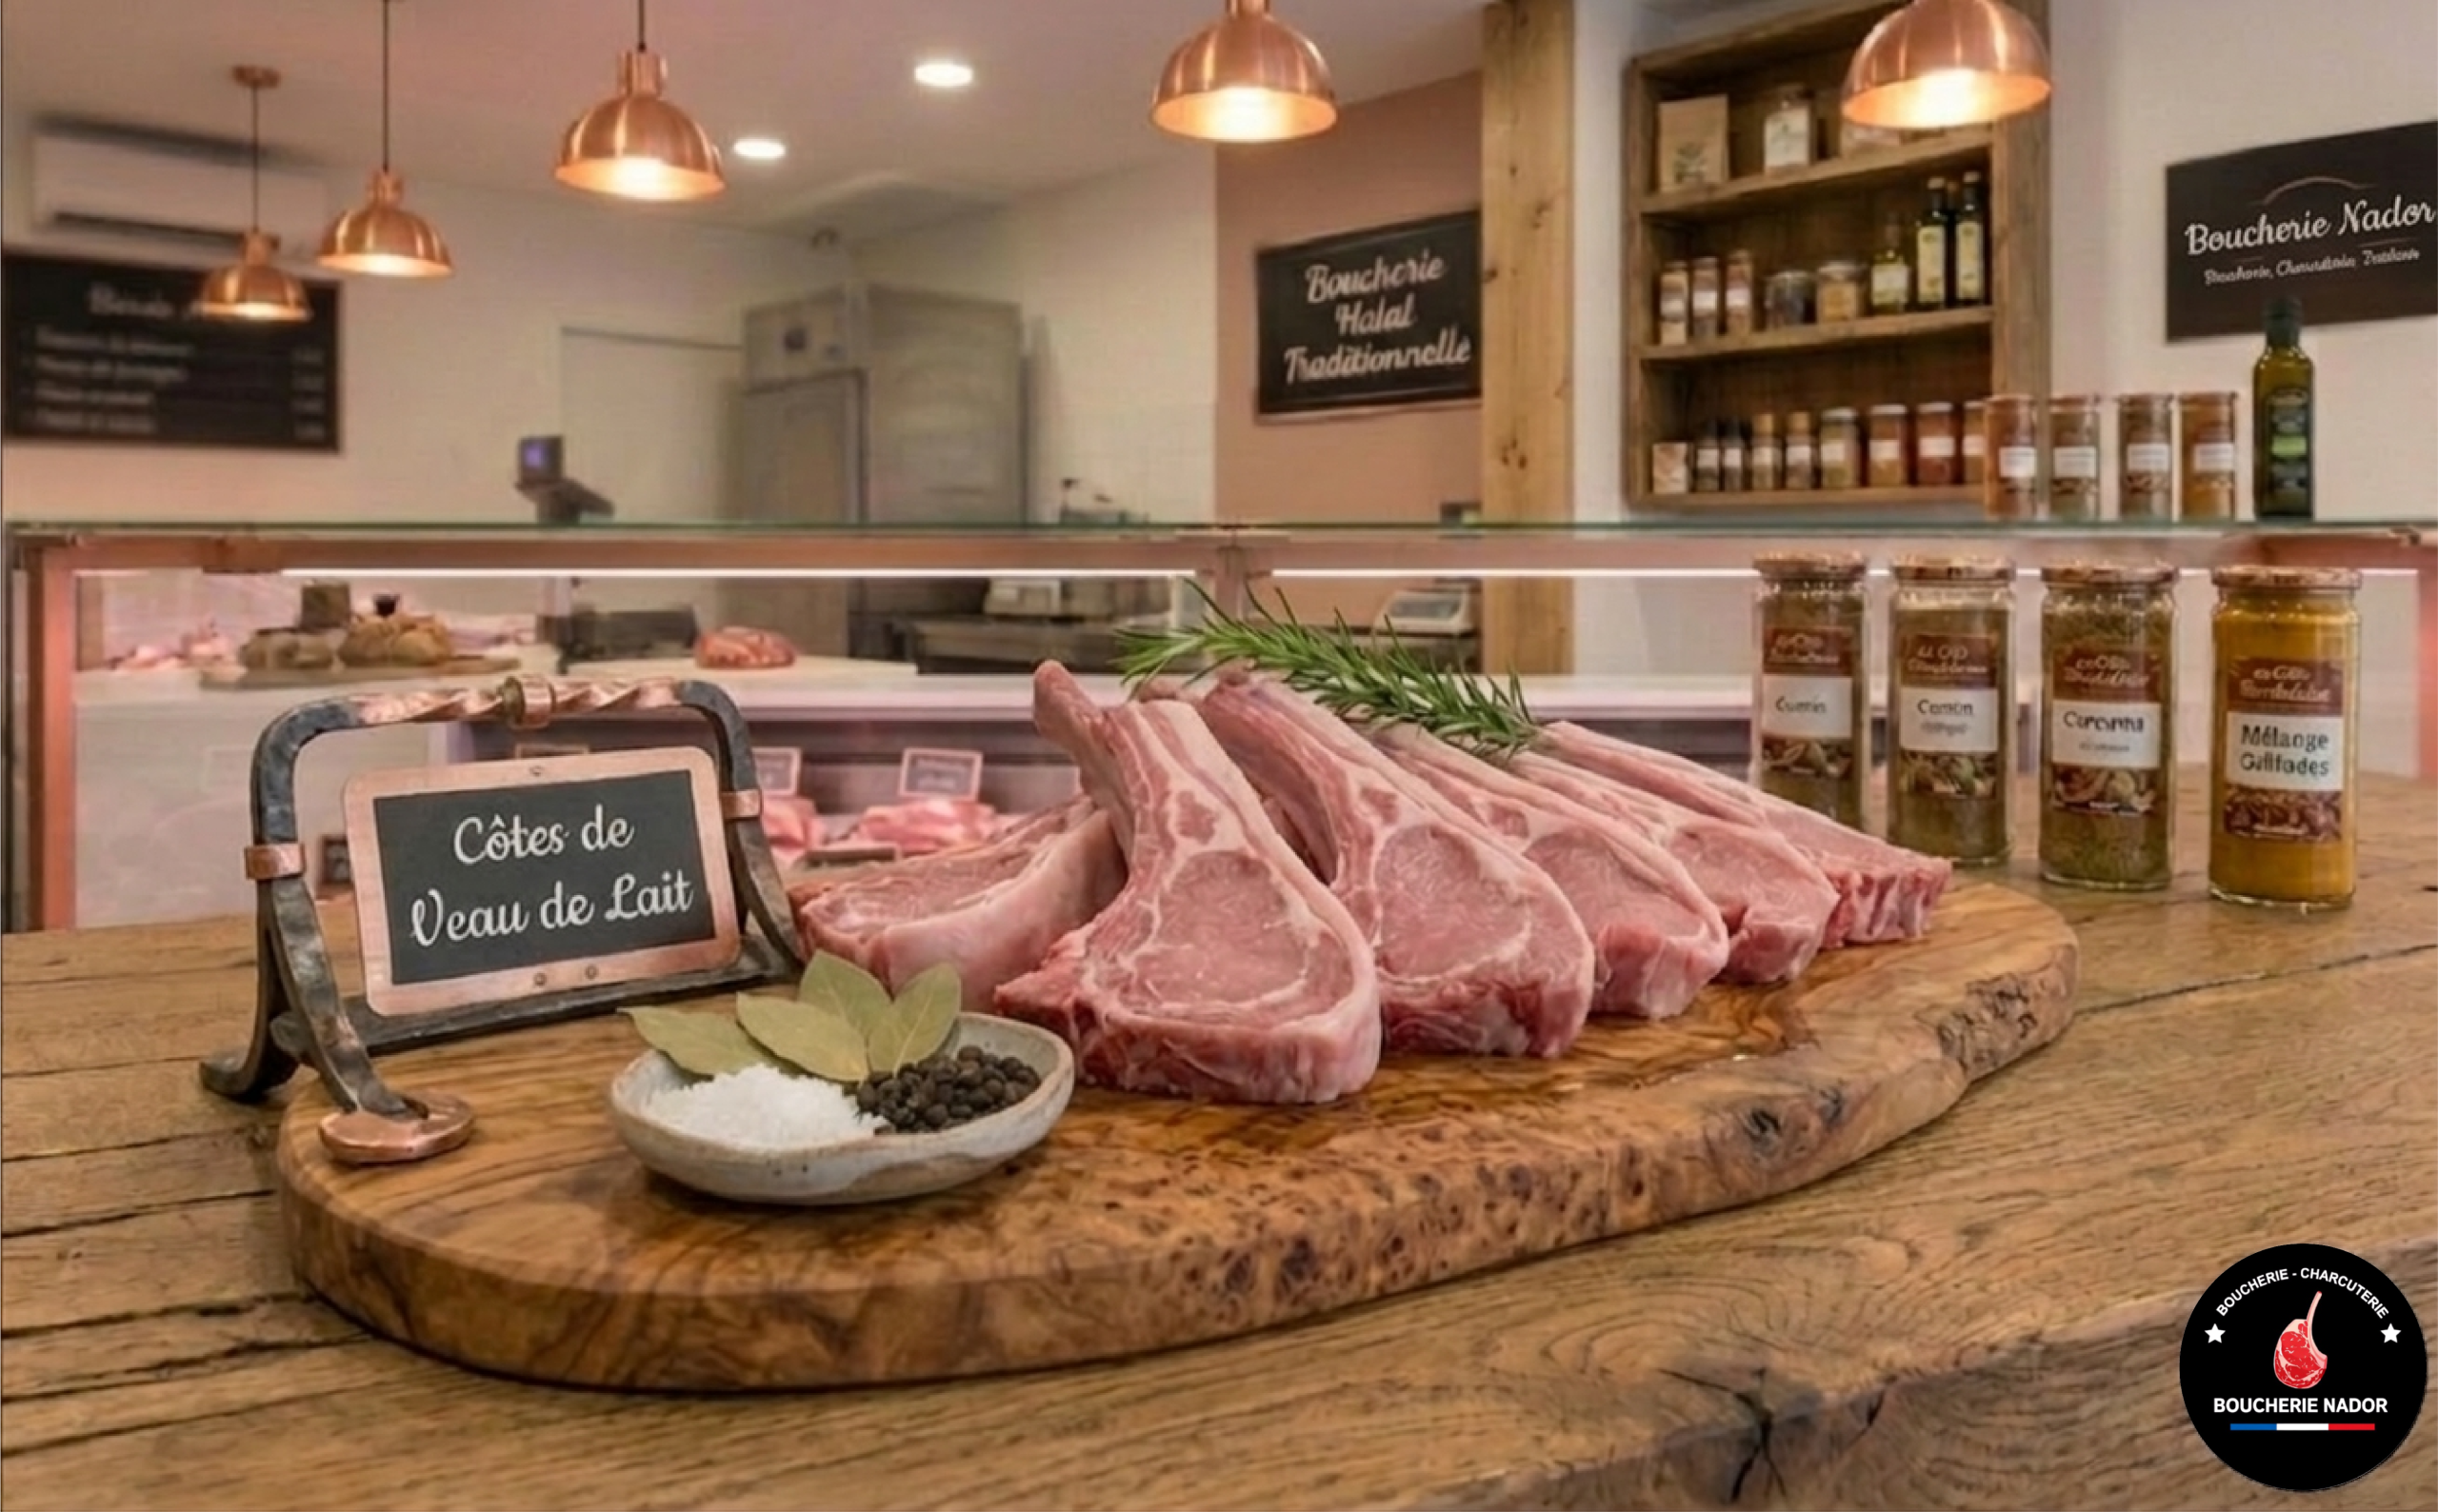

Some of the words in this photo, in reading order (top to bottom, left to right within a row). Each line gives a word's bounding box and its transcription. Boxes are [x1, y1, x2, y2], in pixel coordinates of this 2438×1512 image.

[2185, 209, 2331, 256] Boucherie
[2337, 193, 2437, 236] Nador
[1305, 248, 1446, 304] Boucherie
[1335, 292, 1417, 335] Halal
[1284, 324, 1471, 385] Traditionnelle
[2241, 725, 2329, 753] Mélange
[453, 813, 570, 865] Côtes
[581, 804, 635, 851] de
[410, 887, 530, 947] Veau
[540, 881, 595, 929] de
[605, 869, 695, 920] Lait
